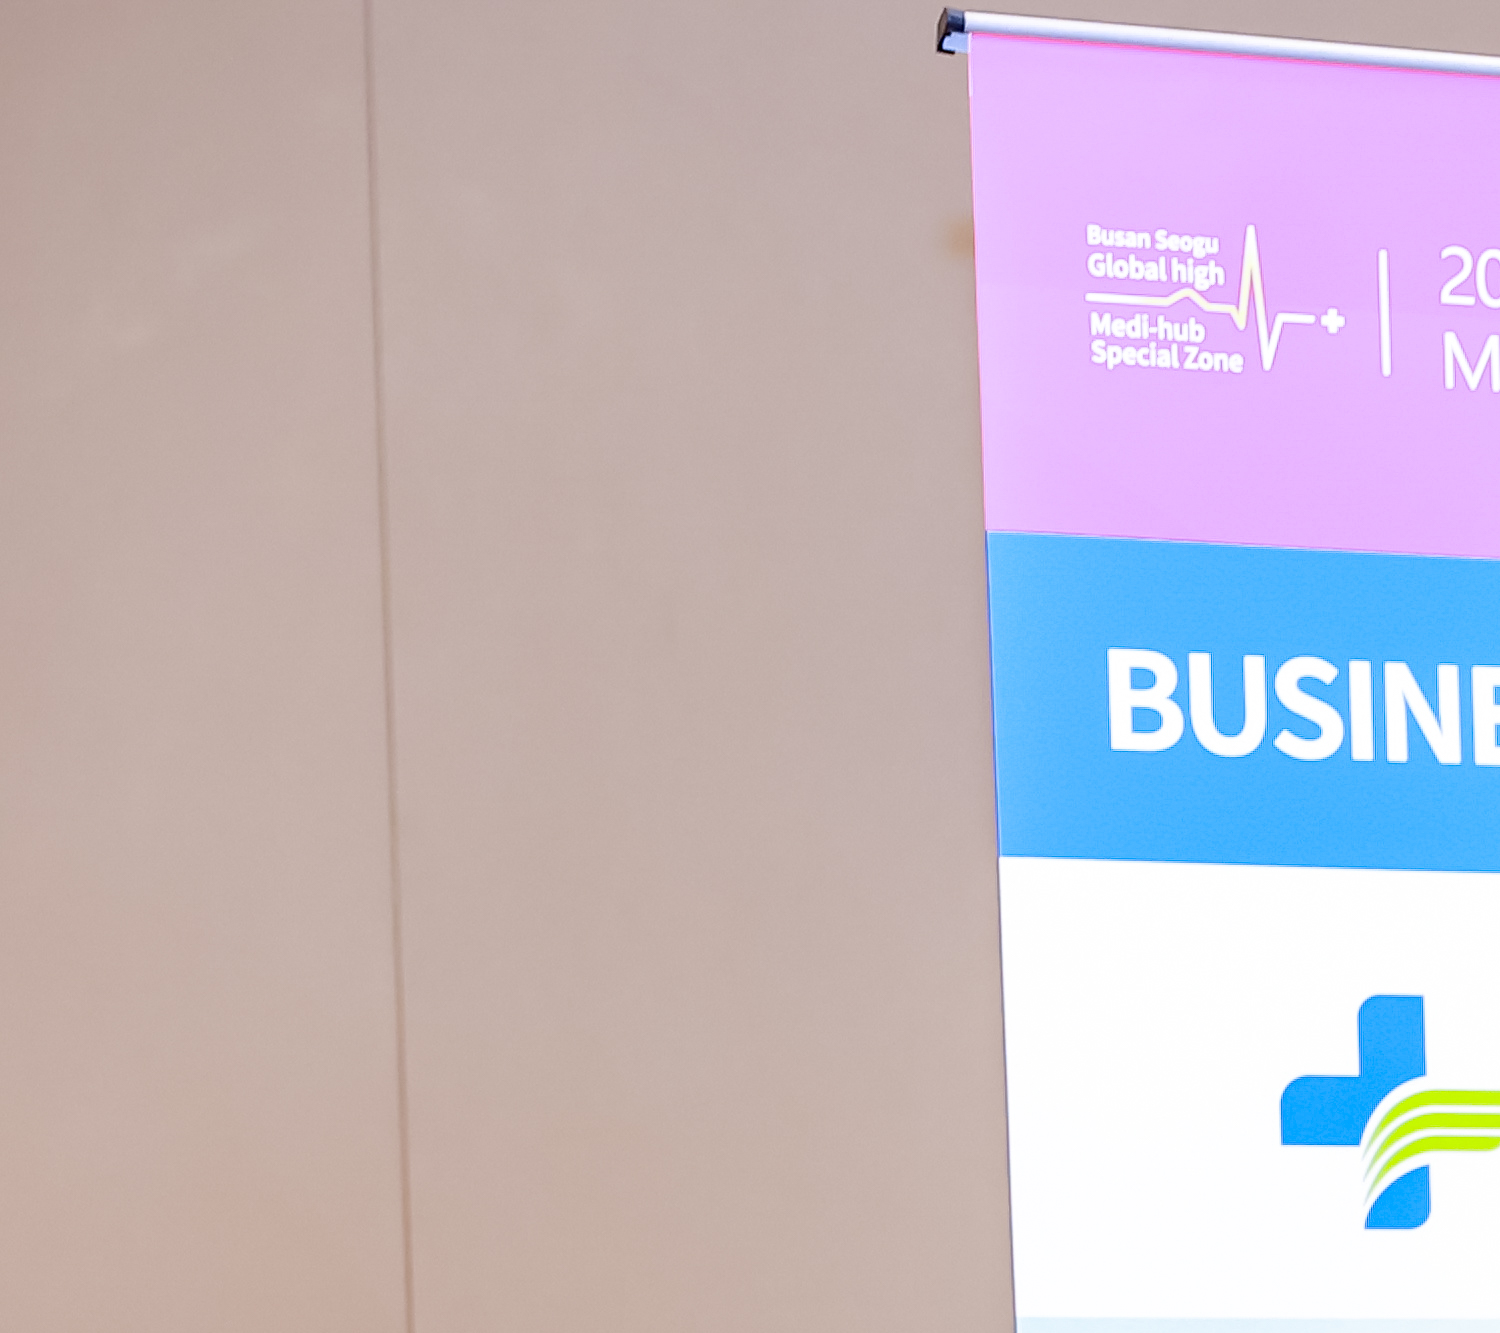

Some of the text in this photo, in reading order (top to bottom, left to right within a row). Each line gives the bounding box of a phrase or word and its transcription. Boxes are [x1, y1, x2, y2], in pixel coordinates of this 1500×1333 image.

[1087, 225, 1219, 258] Busan Seogu
[1088, 253, 1224, 291] Global high
[1091, 312, 1205, 342] Medi-hub
[1092, 340, 1243, 373] Special Zone
